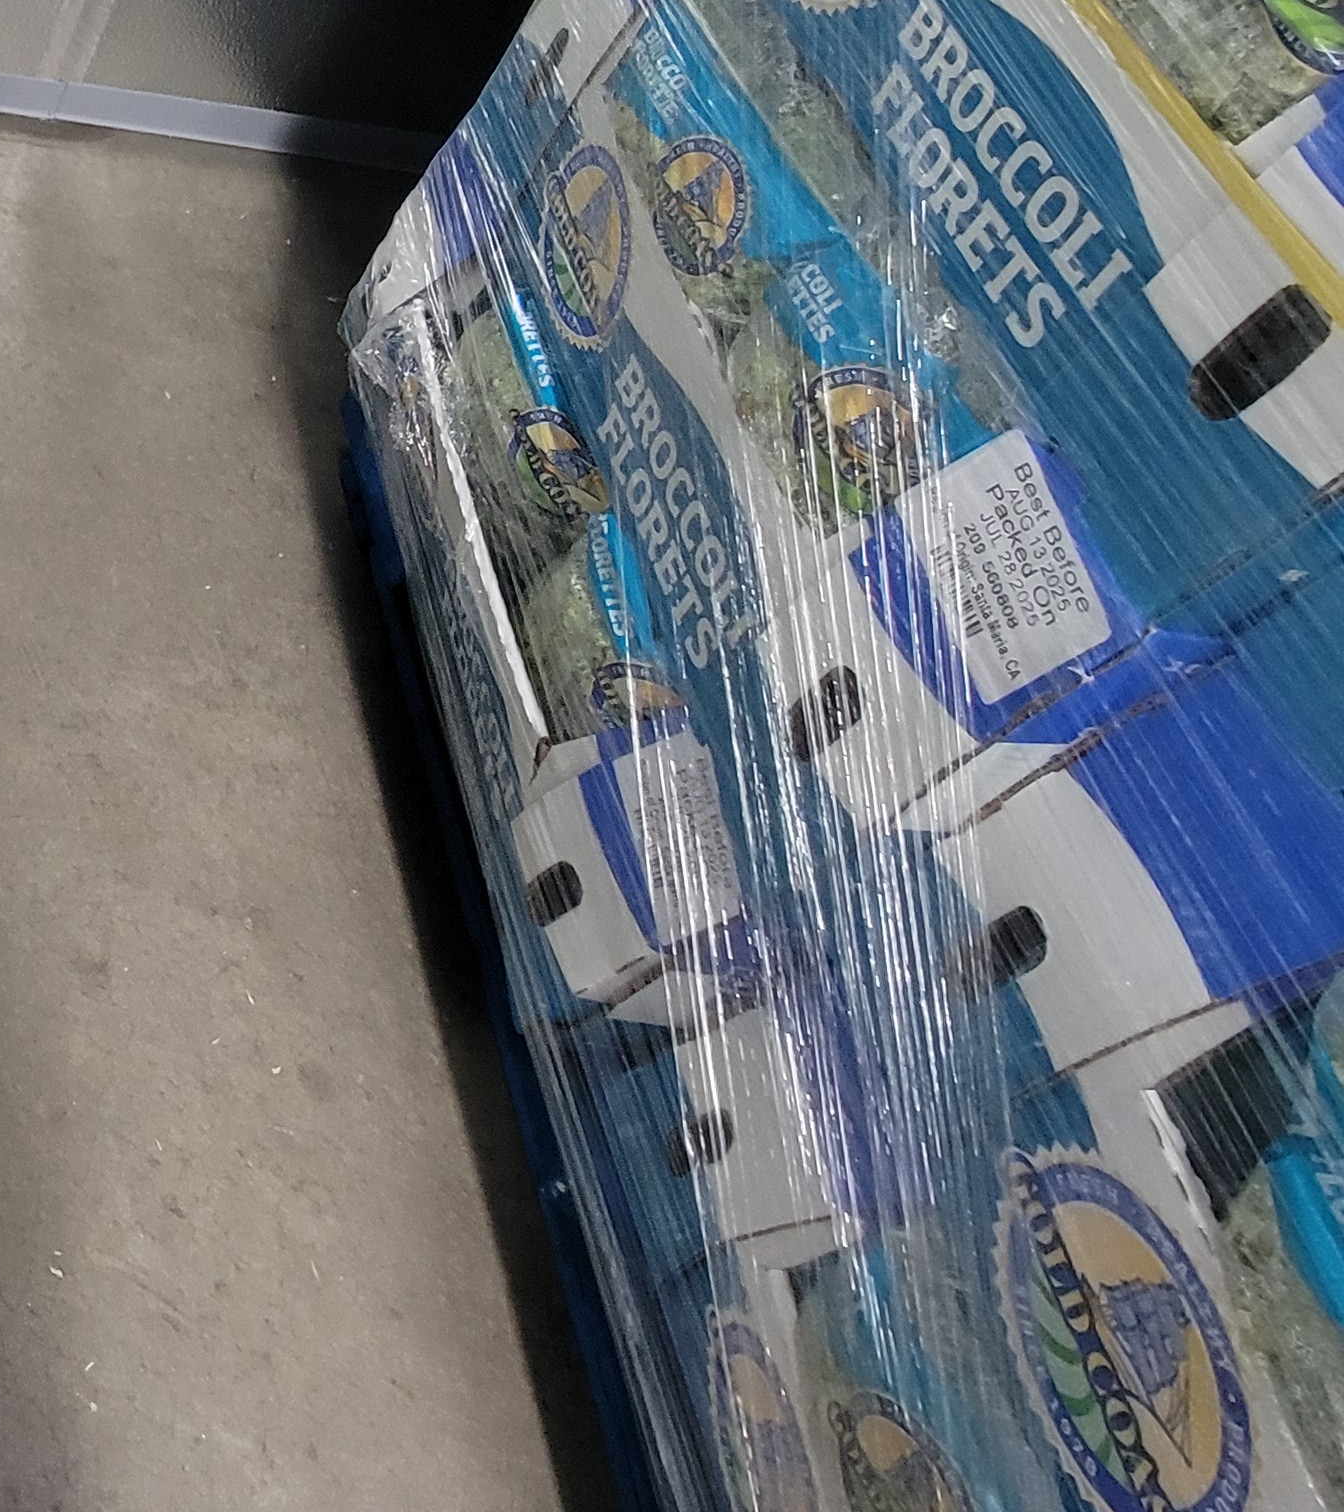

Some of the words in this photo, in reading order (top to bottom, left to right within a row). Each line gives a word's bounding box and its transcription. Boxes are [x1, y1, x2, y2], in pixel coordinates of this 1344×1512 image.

[871, 60, 1068, 349] FLORETS
[596, 403, 716, 671] FLORETS
[615, 353, 757, 651] BROCCOLI
[980, 511, 1005, 550] JUL
[997, 552, 1018, 577] 28
[1008, 580, 1041, 628] 2025
[985, 483, 1040, 580] Packed
[1033, 584, 1058, 628] On
[1005, 487, 1036, 533] AUG
[1028, 535, 1048, 560] 13
[1039, 564, 1072, 613] 2025
[1014, 461, 1053, 523] Best
[1043, 525, 1091, 614] Before
[1004, 659, 1023, 682] CA
